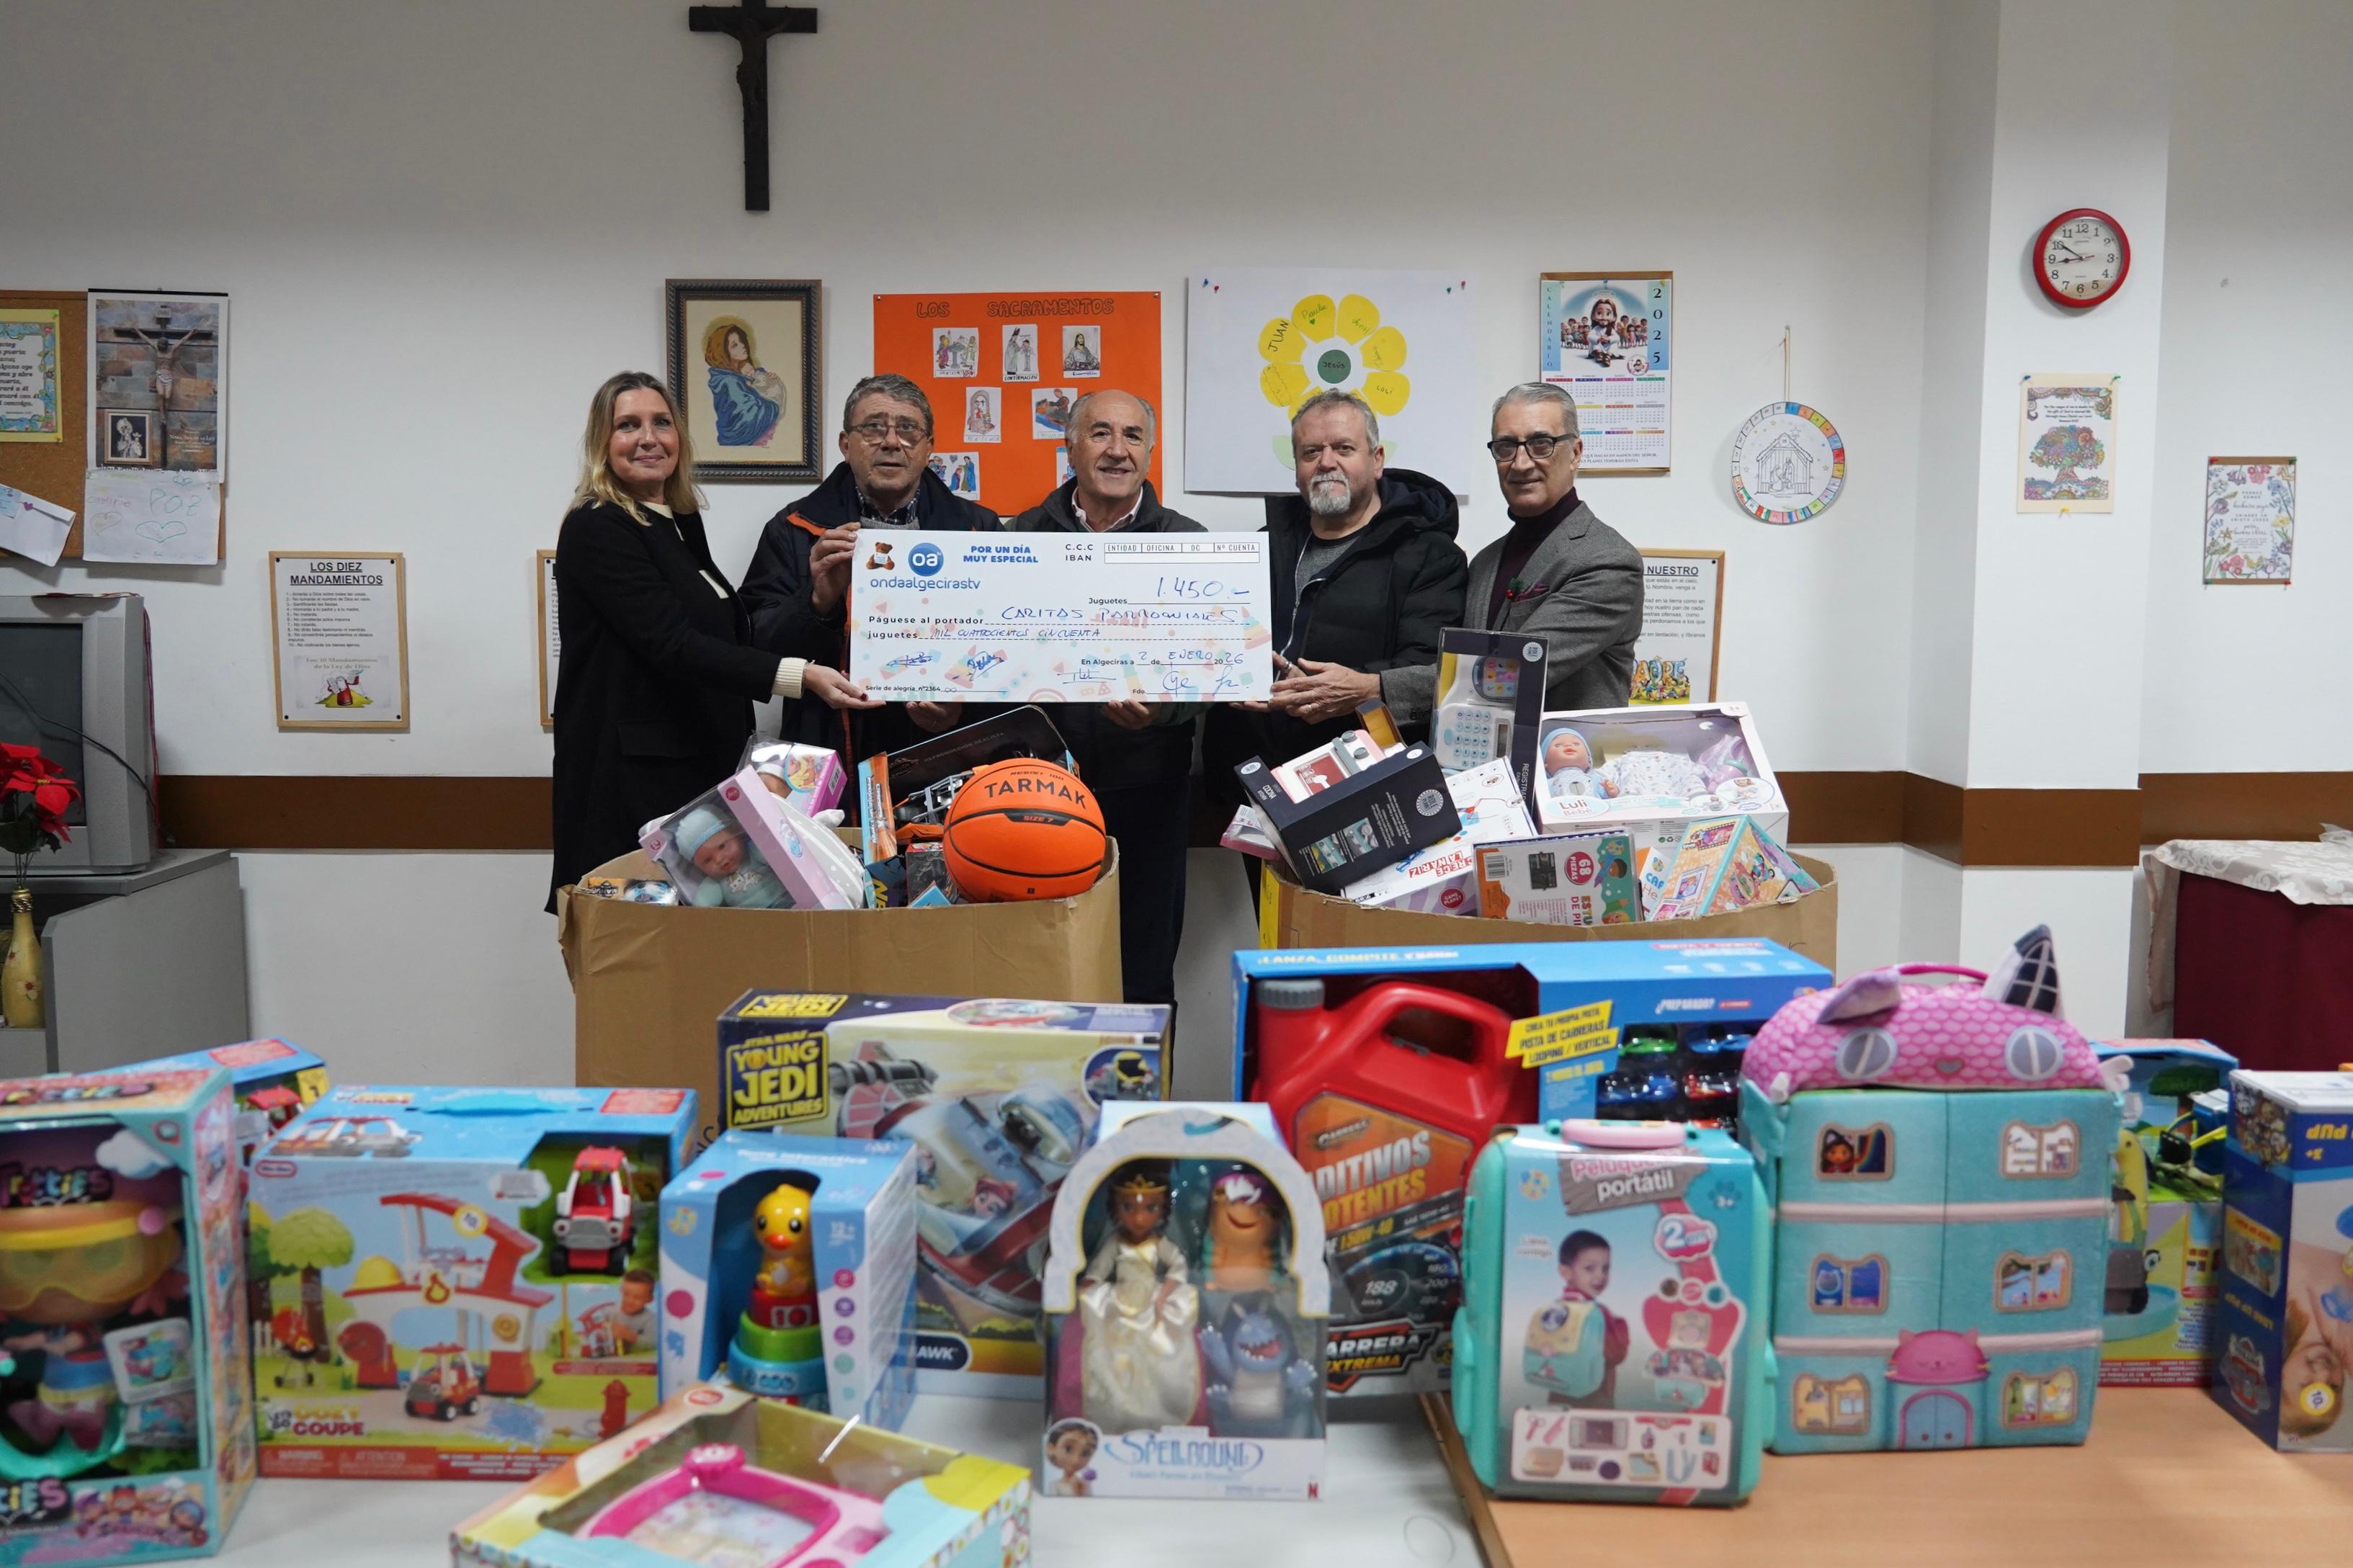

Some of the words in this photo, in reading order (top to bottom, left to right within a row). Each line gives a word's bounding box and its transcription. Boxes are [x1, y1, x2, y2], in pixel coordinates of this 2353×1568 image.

[2062, 229, 2072, 238] 11
[2076, 224, 2089, 233] 12
[2094, 228, 2099, 236] 1
[2048, 254, 2055, 264] 9
[2107, 254, 2115, 263] 3
[2051, 270, 2059, 279] 8
[2102, 269, 2109, 278] 4
[2063, 281, 2069, 290] 7
[2076, 284, 2084, 293] 6
[2092, 280, 2099, 289] 5
[916, 302, 950, 318] LOS
[988, 299, 1114, 318] SACRAMENTOS
[1301, 303, 1327, 320] Paula
[1268, 320, 1289, 352] JUAN
[970, 545, 992, 554] POR
[995, 545, 1010, 554] UN
[1012, 544, 1031, 554] DÍA
[311, 562, 333, 571] LOS
[337, 562, 362, 571] DIEZ
[963, 555, 988, 563] MUY
[1647, 566, 1699, 575] NUESTRO
[290, 575, 383, 585] MANDAMIENTOS
[870, 576, 981, 591] ondaalgecirastv
[869, 616, 916, 625] Páguese
[935, 617, 984, 625] portador
[1001, 606, 1082, 619] CARITAS
[1099, 608, 1238, 624] PARROQUIALES
[930, 628, 952, 638] MIL
[1138, 652, 1147, 660] 2
[1169, 649, 1213, 660] ENERO
[1225, 652, 1244, 664] 26
[974, 731, 1005, 746] REALISTA
[985, 778, 1086, 810] TARMAK
[1428, 794, 1439, 810] ROLE
[1559, 798, 1589, 810] Luli
[1570, 856, 1579, 881] PIEZAS
[1579, 858, 1591, 877] 68
[1442, 896, 1463, 905] PLANET
[1571, 896, 1580, 910] DE
[1519, 1036, 1543, 1050] PISTA
[1547, 1033, 1557, 1044] DE
[1560, 1019, 1605, 1040] CARRERAS
[733, 1039, 820, 1072] YOUNG
[1528, 1046, 1563, 1063] LOOPING
[1574, 1034, 1611, 1052] VERTICAL
[733, 1062, 818, 1106] JEDI
[733, 1098, 824, 1124] ADVENTURES
[1313, 1129, 1431, 1201] DITIVOS
[1596, 1169, 1674, 1203] portátil
[1323, 1168, 1426, 1232] OTENTES
[1664, 1220, 1686, 1250] 2
[1365, 1280, 1398, 1295] 188
[911, 1343, 954, 1363] AWK
[1326, 1333, 1420, 1358] ARRERA
[1326, 1354, 1401, 1372] XTREMA
[293, 1421, 365, 1436] COUPE
